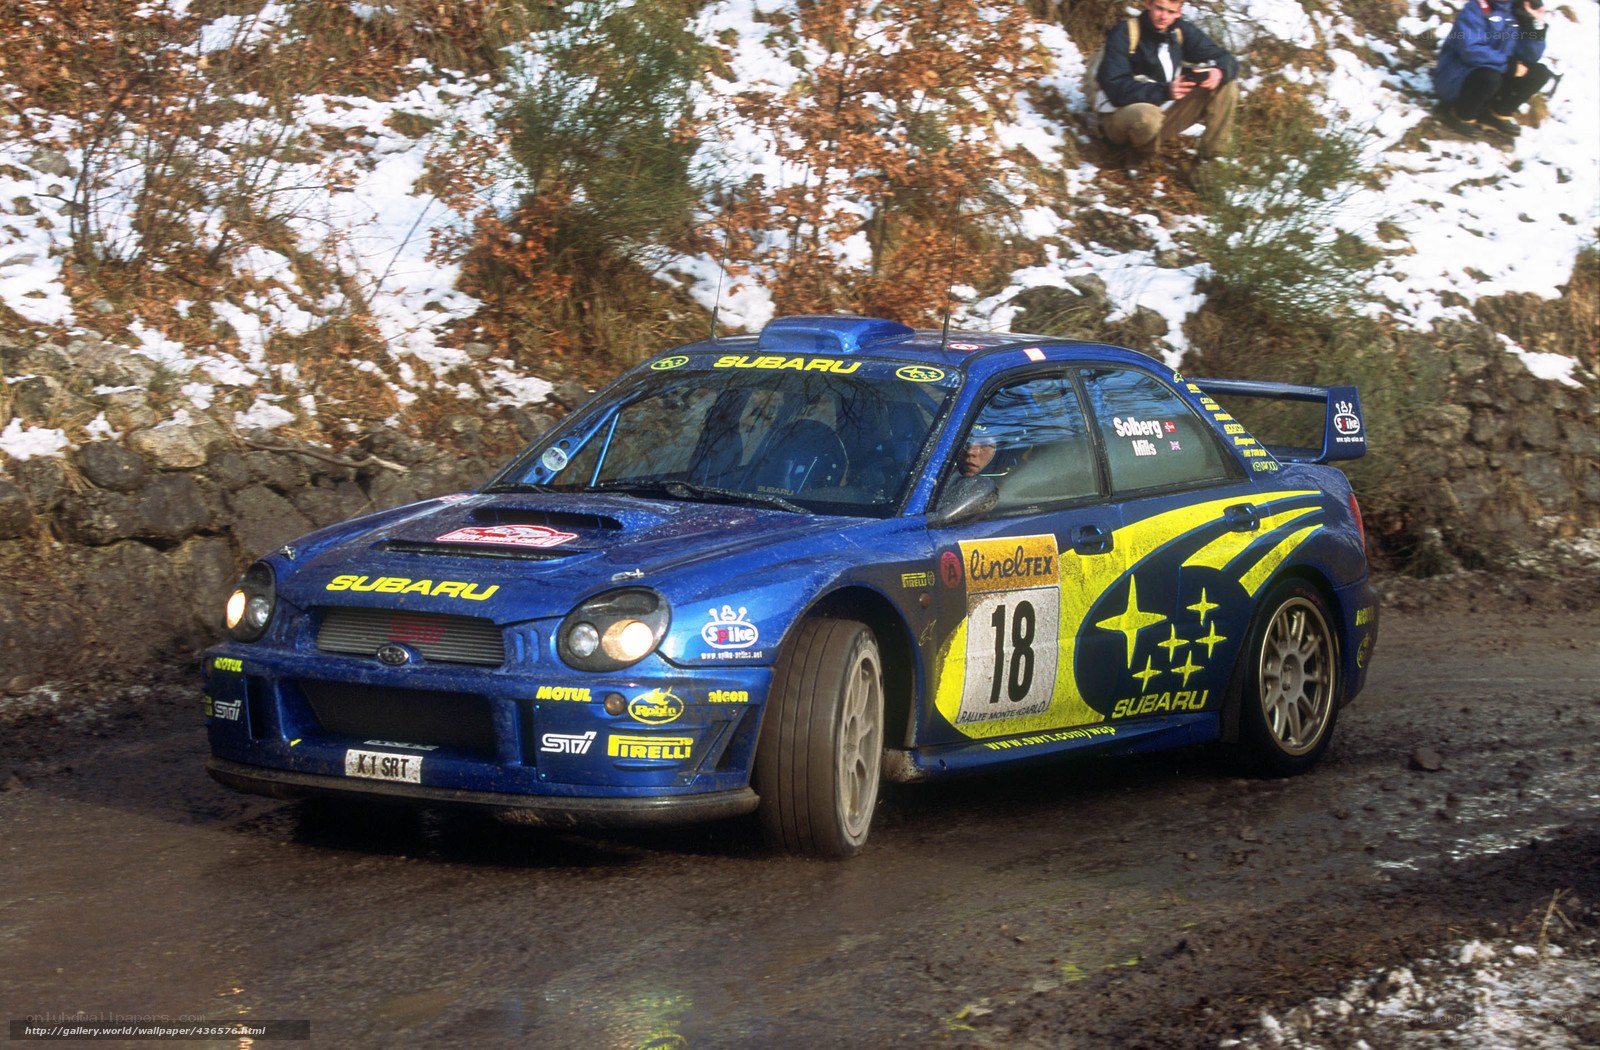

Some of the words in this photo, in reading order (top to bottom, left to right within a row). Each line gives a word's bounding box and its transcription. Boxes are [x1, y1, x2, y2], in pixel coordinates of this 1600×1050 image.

[713, 355, 862, 374] SUBARU
[1113, 416, 1163, 439] Solberg
[1131, 439, 1157, 456] Mills
[757, 485, 794, 496] SUBARU
[326, 574, 500, 601] SUBARU
[901, 571, 928, 588] PIRELLI
[707, 626, 755, 645] Spike
[990, 599, 1036, 704] 18
[213, 656, 244, 673] MOTUL
[535, 685, 593, 702] MOTUL
[708, 689, 749, 703] alcon
[1111, 689, 1209, 719] SUBARU
[961, 710, 986, 723] RALLYE
[607, 734, 694, 759] PIRELLI
[381, 756, 410, 778] SRT
